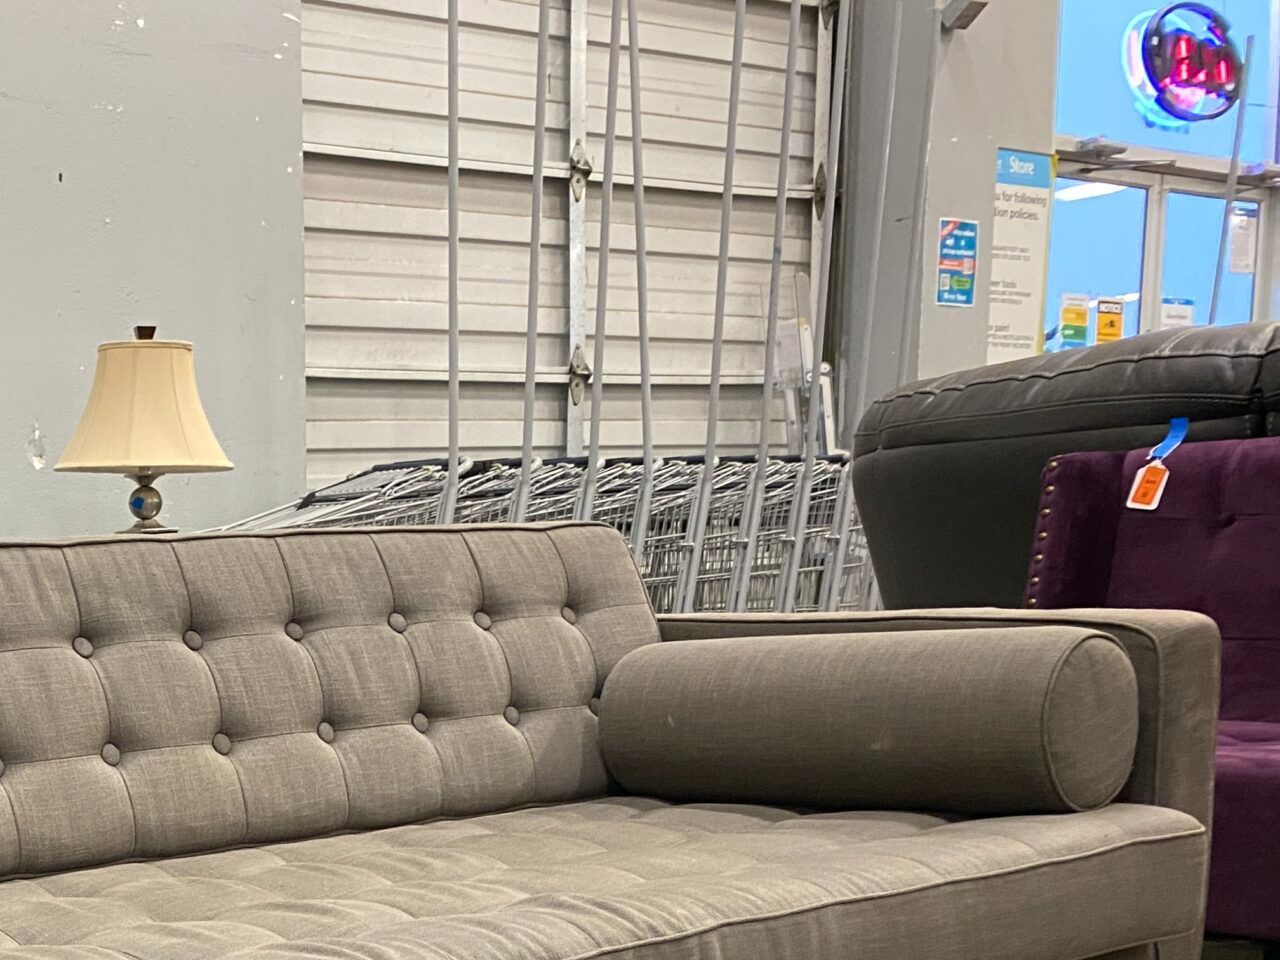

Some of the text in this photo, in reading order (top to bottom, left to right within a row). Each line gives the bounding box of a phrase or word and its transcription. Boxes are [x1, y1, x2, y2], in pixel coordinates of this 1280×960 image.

[1009, 155, 1035, 175] Store
[1002, 190, 1014, 202] for
[1014, 192, 1047, 208] following
